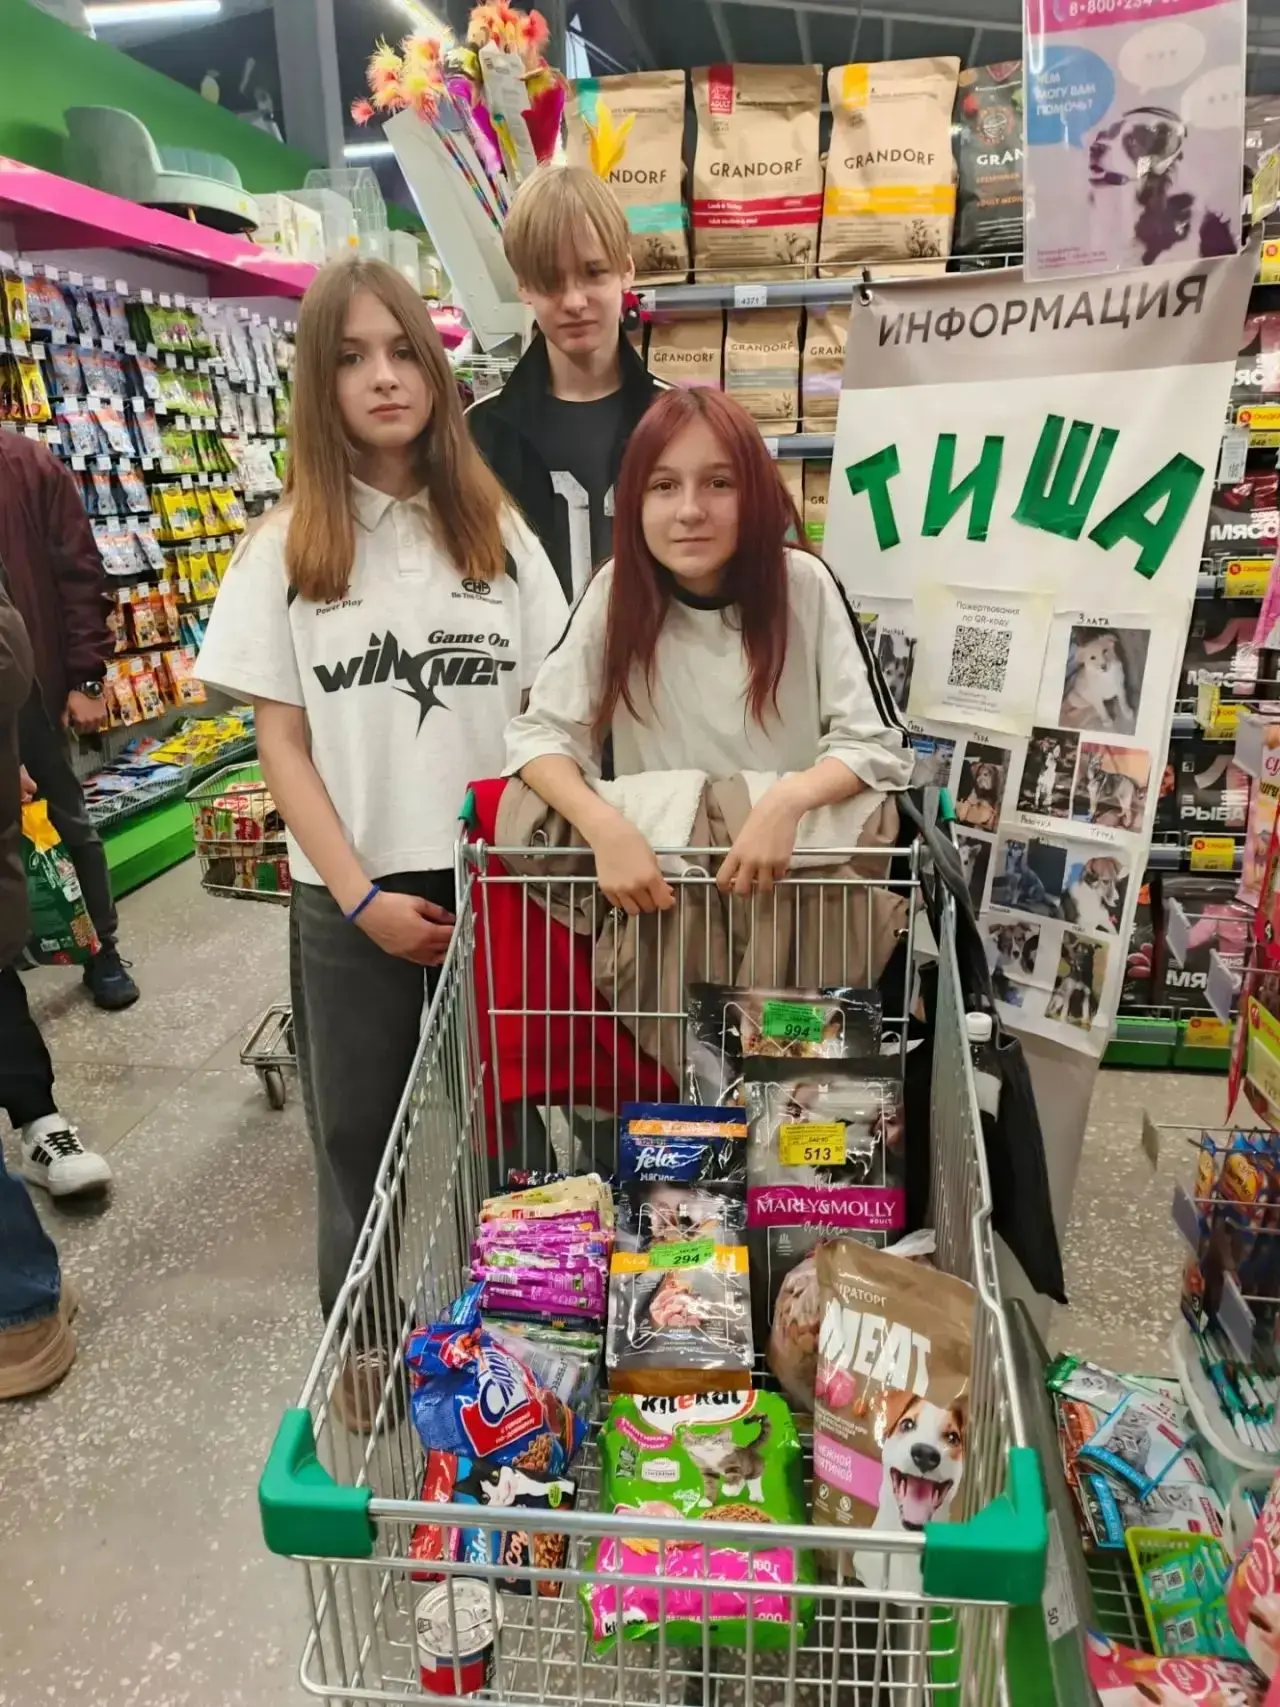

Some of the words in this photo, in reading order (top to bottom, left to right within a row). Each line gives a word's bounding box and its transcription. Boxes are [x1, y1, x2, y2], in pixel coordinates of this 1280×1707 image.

[1070, 84, 1096, 96] ВАМ
[844, 148, 935, 169] GRANDORF
[976, 148, 1024, 166] GRAN
[709, 158, 803, 178] GRANDORF
[878, 274, 1208, 347] ИНФОРМАЦИЯ
[731, 342, 794, 352] GRANDORF
[810, 345, 845, 356] GRAN
[653, 352, 715, 362] GRANDORF
[845, 414, 1205, 580] ТИША
[1210, 524, 1279, 541] МЯСО
[316, 605, 339, 616] Power
[342, 599, 363, 609] Play
[956, 601, 1020, 616] Пожертвования
[428, 630, 484, 645] Game
[488, 633, 510, 648] On
[1180, 806, 1246, 820] РЫБА
[784, 1023, 810, 1038] 994
[804, 1147, 831, 1161] 513
[756, 1199, 896, 1216] MARLY&MOLLY
[673, 1254, 700, 1265] 294
[818, 1296, 931, 1398] MEAT
